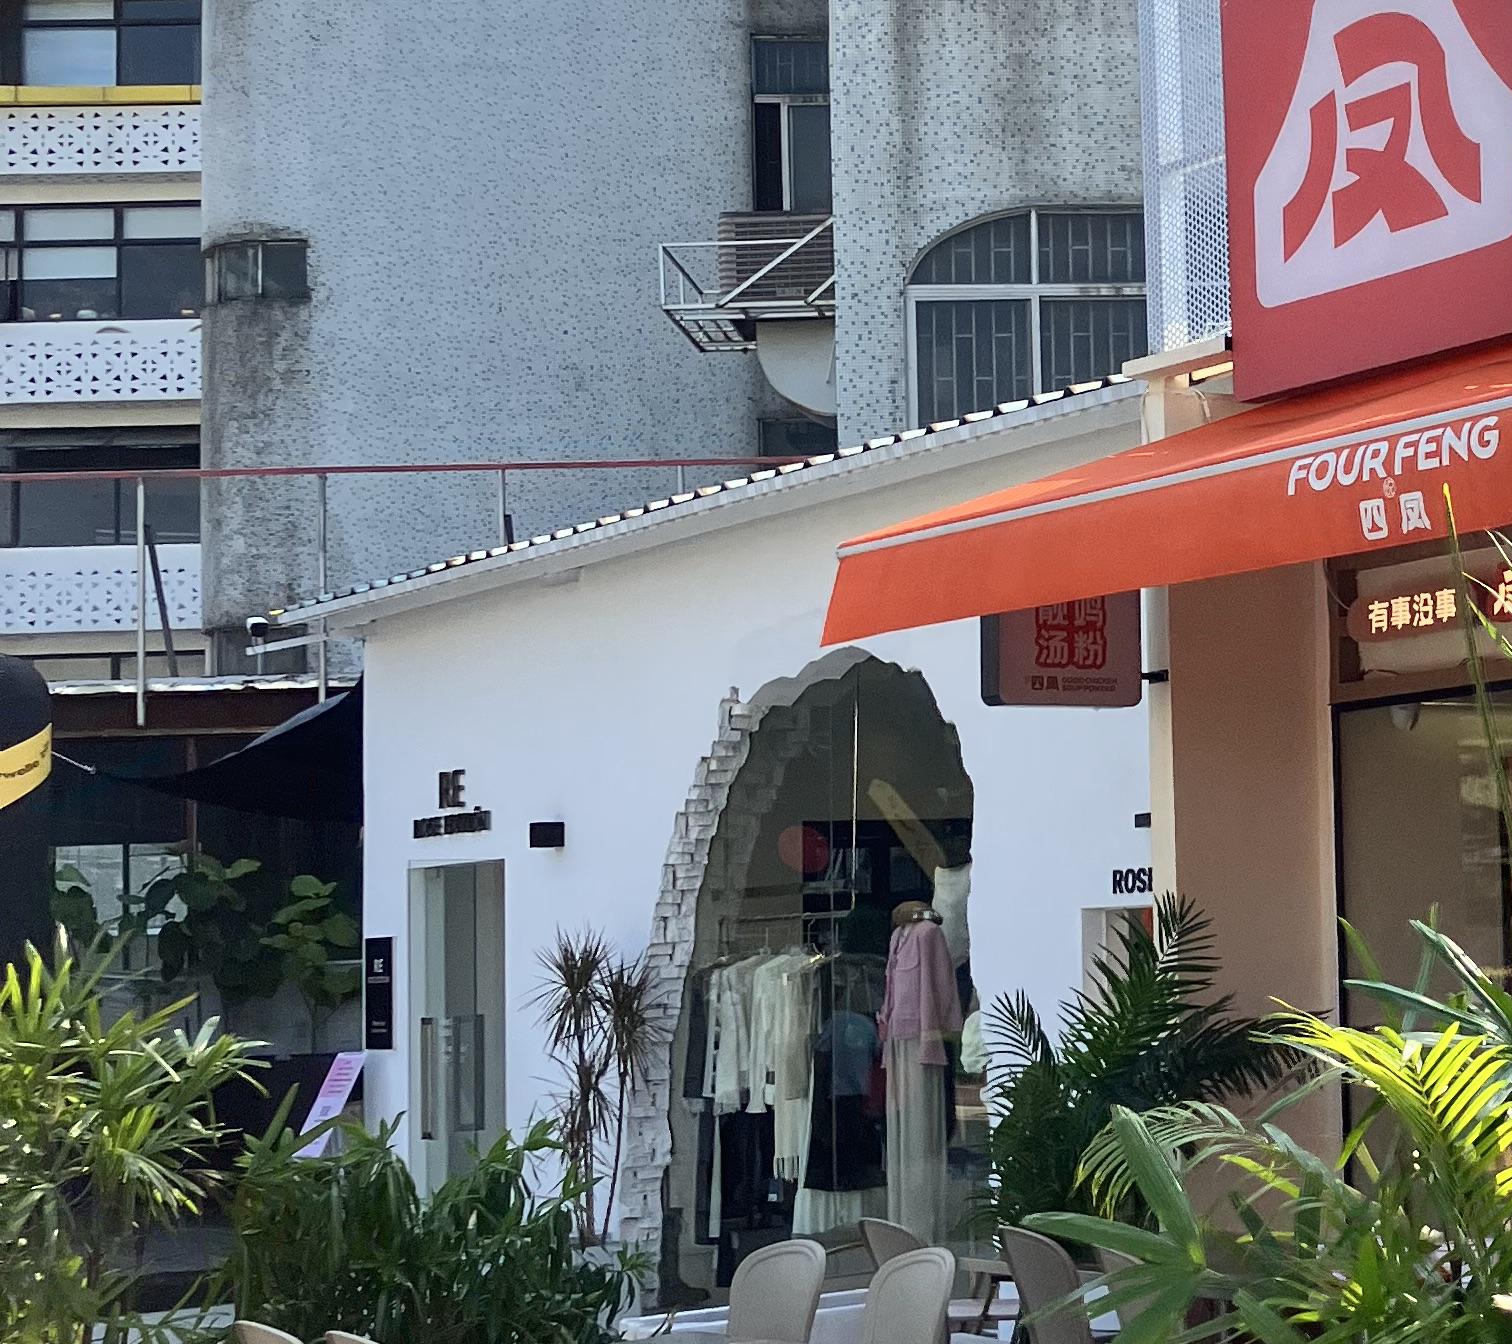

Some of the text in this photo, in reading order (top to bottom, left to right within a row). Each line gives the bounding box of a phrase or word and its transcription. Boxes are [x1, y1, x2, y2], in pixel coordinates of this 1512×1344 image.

[1287, 415, 1500, 496] FOUR FENG
[1359, 490, 1432, 541] 四凤
[1368, 587, 1457, 635] 有事没事
